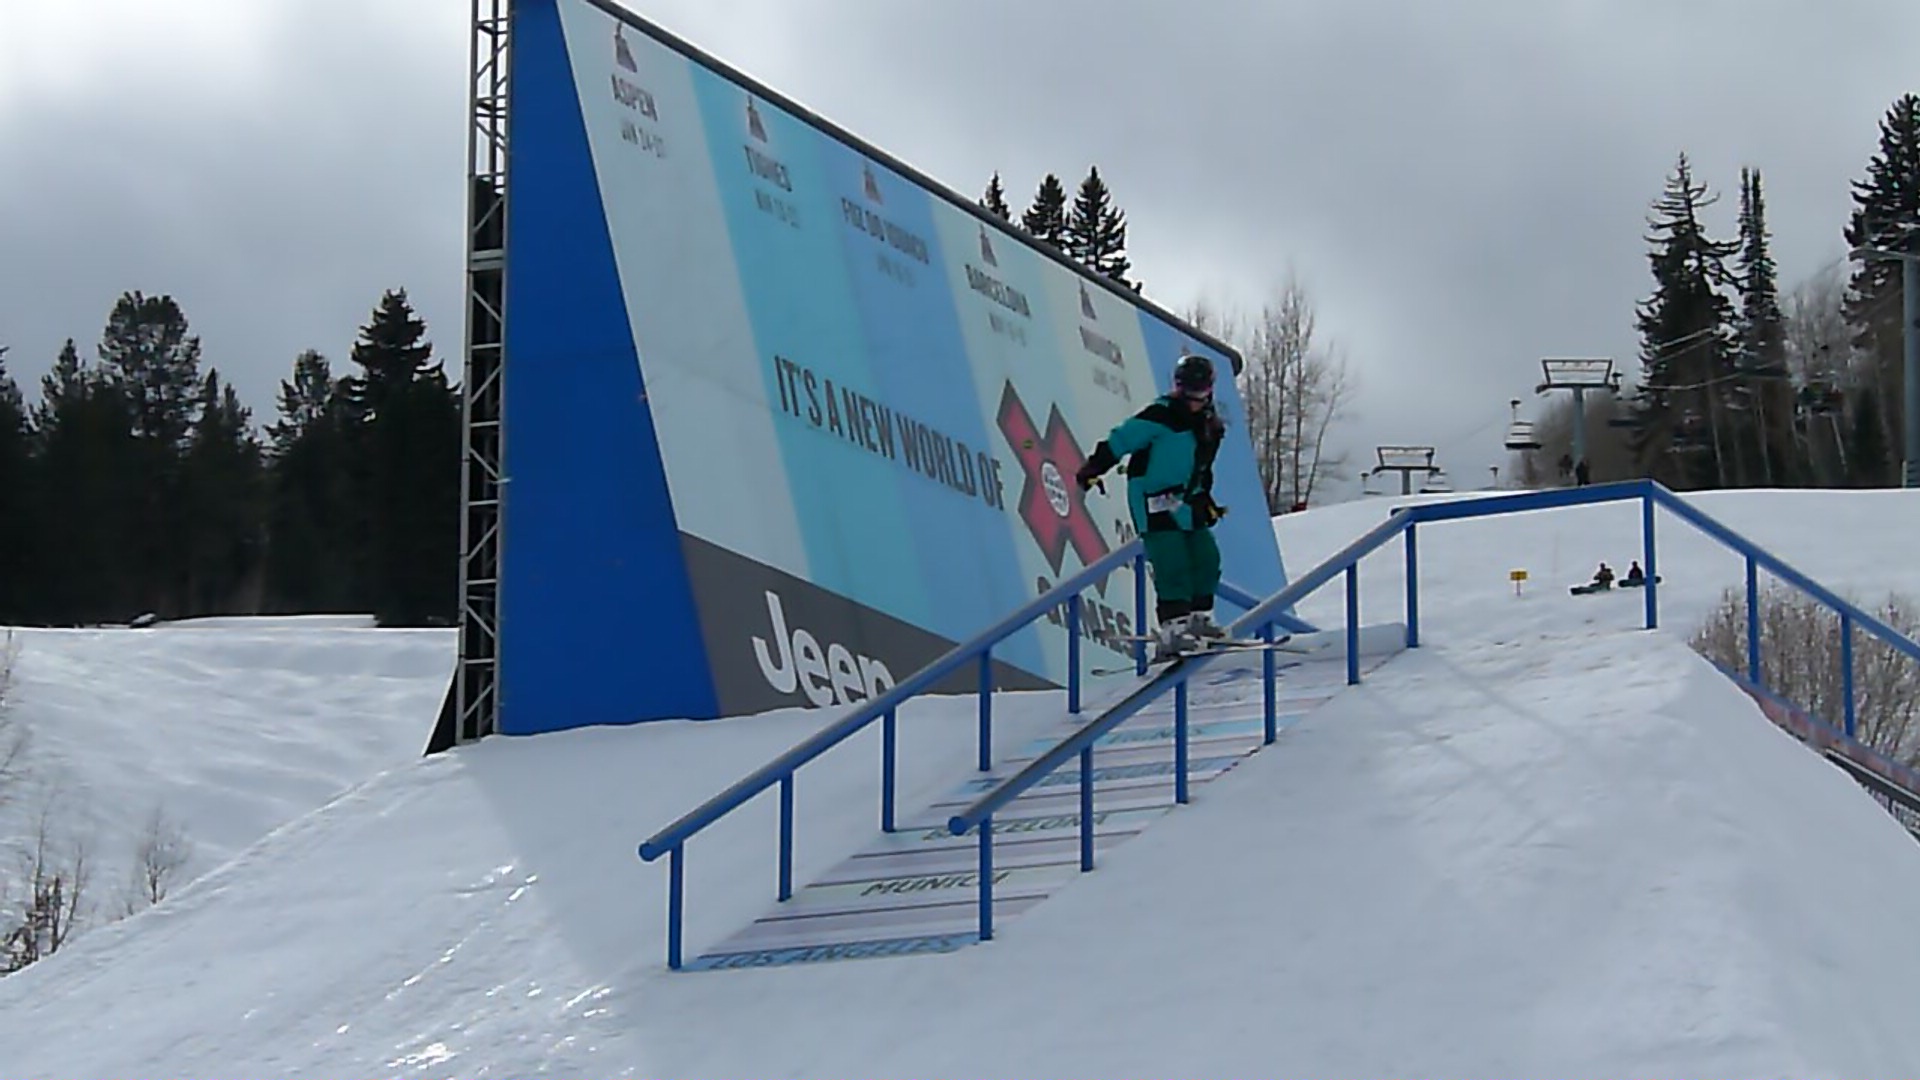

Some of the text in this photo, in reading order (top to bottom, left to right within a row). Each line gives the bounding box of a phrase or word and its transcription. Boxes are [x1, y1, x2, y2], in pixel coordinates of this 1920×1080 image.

[611, 74, 658, 122] ASPEN
[774, 355, 822, 427] IT'S
[824, 379, 844, 438] A
[841, 387, 896, 460] NEW
[895, 412, 977, 497] WORLD
[978, 452, 1004, 511] OF
[1037, 575, 1138, 661] GMES
[922, 813, 1110, 840] BCELON
